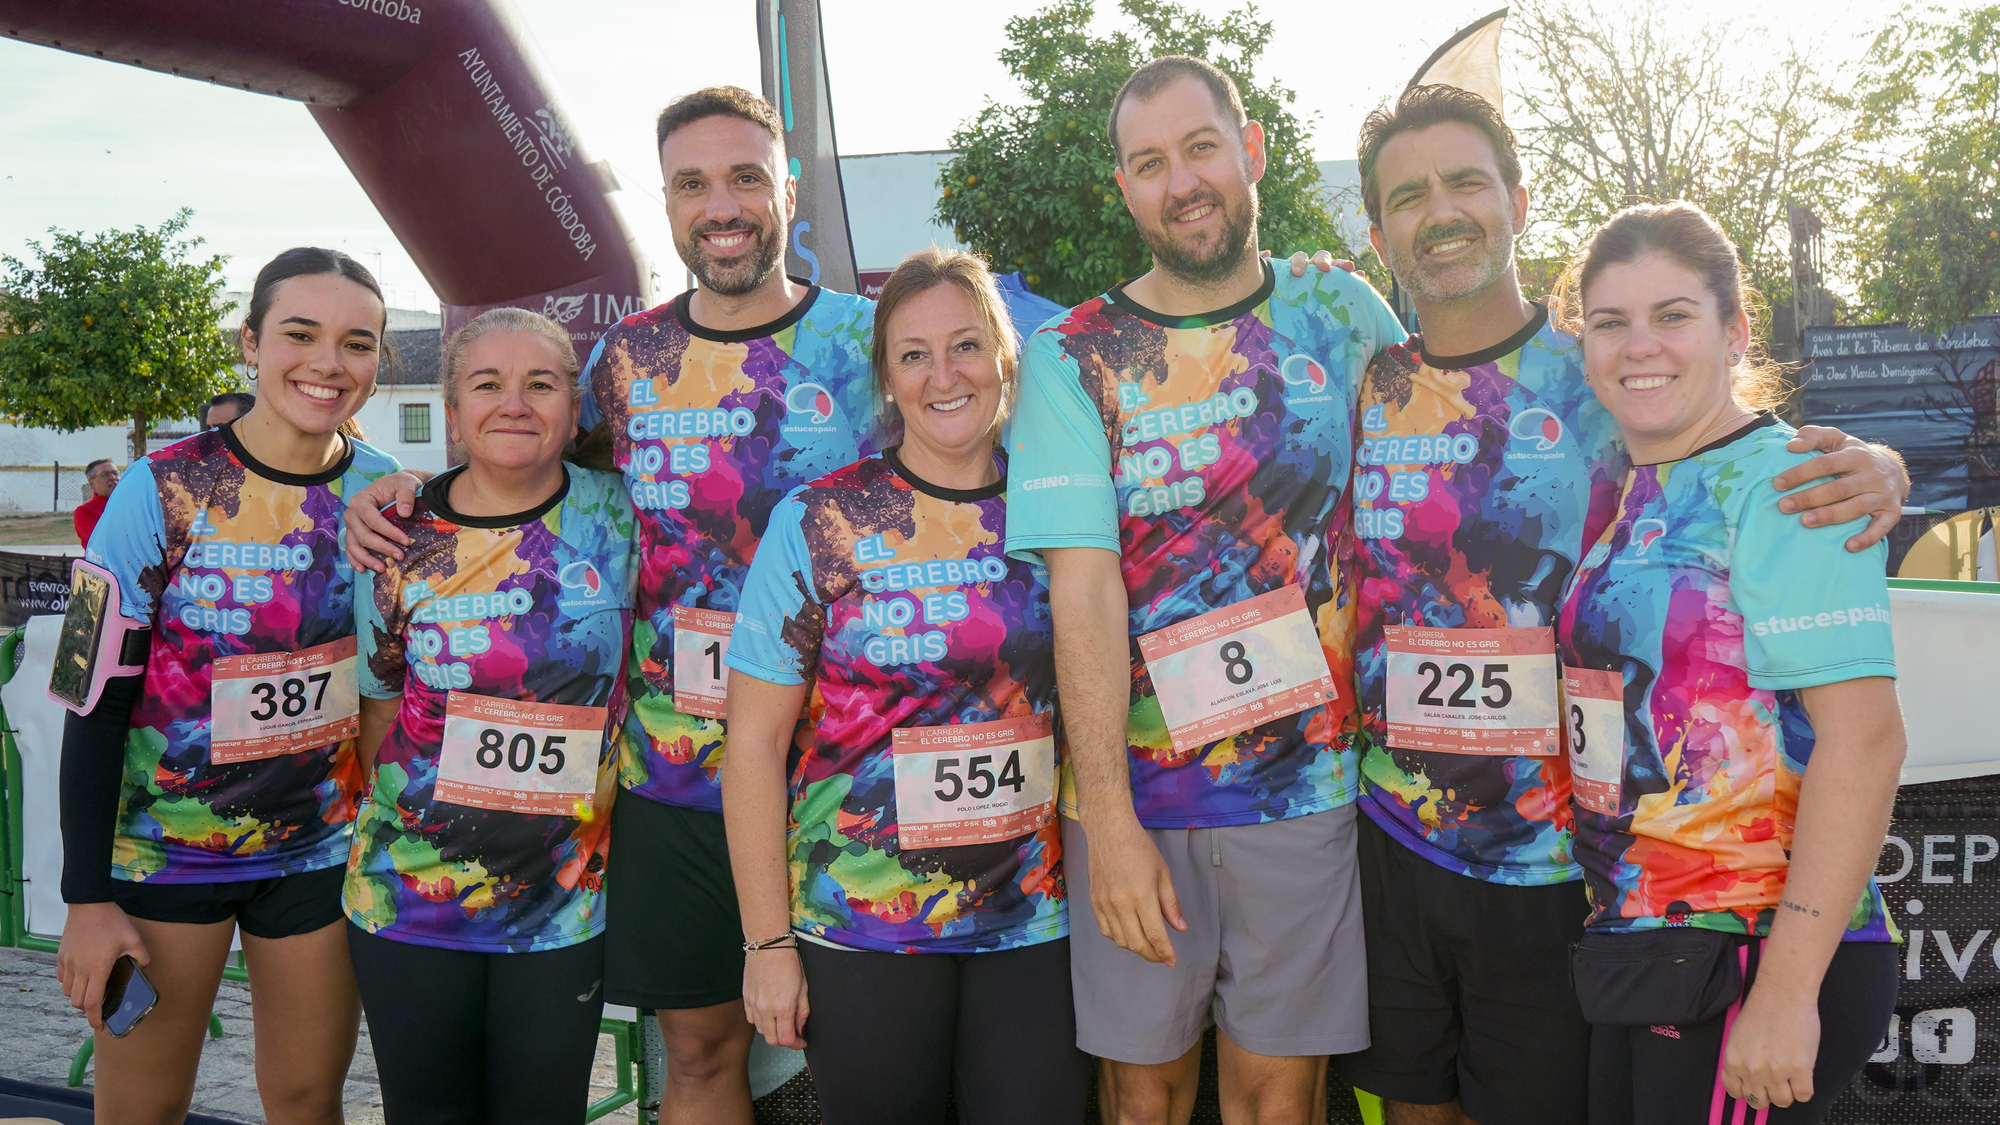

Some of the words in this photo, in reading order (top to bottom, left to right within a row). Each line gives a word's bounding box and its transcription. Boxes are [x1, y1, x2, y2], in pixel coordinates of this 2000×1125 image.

[458, 46, 541, 168] AYUNTAMIENTO
[530, 162, 555, 191] DE
[545, 185, 598, 262] CÓRDOBA
[1811, 343, 1834, 358] Aves
[1837, 341, 1850, 356] de
[1854, 340, 1867, 355] la
[1872, 338, 1913, 353] Ribera
[1914, 334, 1930, 351] de
[1836, 331, 1879, 341] INFANTIL
[1811, 368, 1825, 382] de
[1826, 365, 1849, 381] José
[1850, 364, 1878, 380] María
[631, 381, 657, 405] EL
[1120, 385, 1148, 411] EL
[1287, 394, 1333, 405] astucespain
[629, 410, 751, 438] CEREBRO
[1122, 389, 1255, 444] CEREBRO
[1363, 405, 1388, 430] EL
[783, 425, 837, 435] astucespain
[629, 448, 662, 474] NO
[672, 446, 709, 471] ES
[1122, 450, 1169, 483] NO
[1181, 437, 1218, 468] ES
[1359, 435, 1476, 465] CEREBRO
[1506, 450, 1566, 461] astucespain
[1022, 475, 1070, 491] GEINO
[1354, 474, 1382, 500] NO
[1391, 473, 1428, 499] ES
[631, 484, 688, 509] GRIS
[1129, 479, 1203, 515] GRIS
[191, 511, 216, 534] EL
[1354, 510, 1403, 538] GRIS
[187, 543, 310, 569] CEREBRO
[856, 535, 894, 562] EL
[863, 559, 1005, 590] CEREBRO
[28, 581, 70, 594] EVENTOS
[180, 576, 223, 600] NO
[236, 577, 273, 601] ES
[405, 583, 435, 607] EL
[561, 598, 608, 608] astucespain
[864, 600, 912, 628] NO
[925, 594, 967, 622] ES
[181, 608, 250, 633] GRIS
[700, 613, 732, 622] CARRERA
[1169, 637, 1178, 646] EL
[1179, 625, 1216, 642] CEREBRO
[1217, 620, 1230, 630] NO
[1231, 615, 1241, 625] ES
[1241, 609, 1261, 621] GRIS
[1172, 619, 1208, 636] CARRERA
[1748, 603, 1891, 637] stucespain
[411, 631, 440, 655] NO
[451, 628, 490, 654] ES
[1413, 631, 1445, 639] CARRERA
[1417, 639, 1450, 647] CEREBRO
[246, 654, 282, 664] CARRERA
[866, 635, 945, 664] GRIS
[240, 664, 250, 672] EL
[252, 661, 286, 671] CEREBRO
[287, 658, 298, 666] NO
[307, 653, 324, 662] GRIS
[1219, 640, 1253, 685] 8
[416, 664, 470, 688] GRIS
[1417, 661, 1513, 708] 225
[250, 671, 332, 721] 387
[675, 692, 698, 700] novocure
[1210, 694, 1236, 707] ALARCON
[1256, 682, 1270, 691] JOSE
[1270, 678, 1282, 687] LUIS
[480, 700, 516, 710] CARRERA
[484, 708, 520, 718] CEREBRO
[521, 713, 534, 721] NO
[297, 715, 323, 725] ESPERANZA
[1170, 723, 1199, 737] novocure
[1202, 714, 1226, 726] SERVIER
[1569, 704, 1586, 754] 3
[926, 728, 964, 737] CARRERA
[932, 735, 971, 744] CEREBRO
[997, 729, 1015, 737] GRIS
[1461, 730, 1476, 738] bida
[476, 728, 566, 775] 805
[437, 780, 464, 789] novocure
[467, 785, 490, 793] SERVIER
[934, 749, 1025, 802] 554
[1650, 1025, 1681, 1039] adidas
